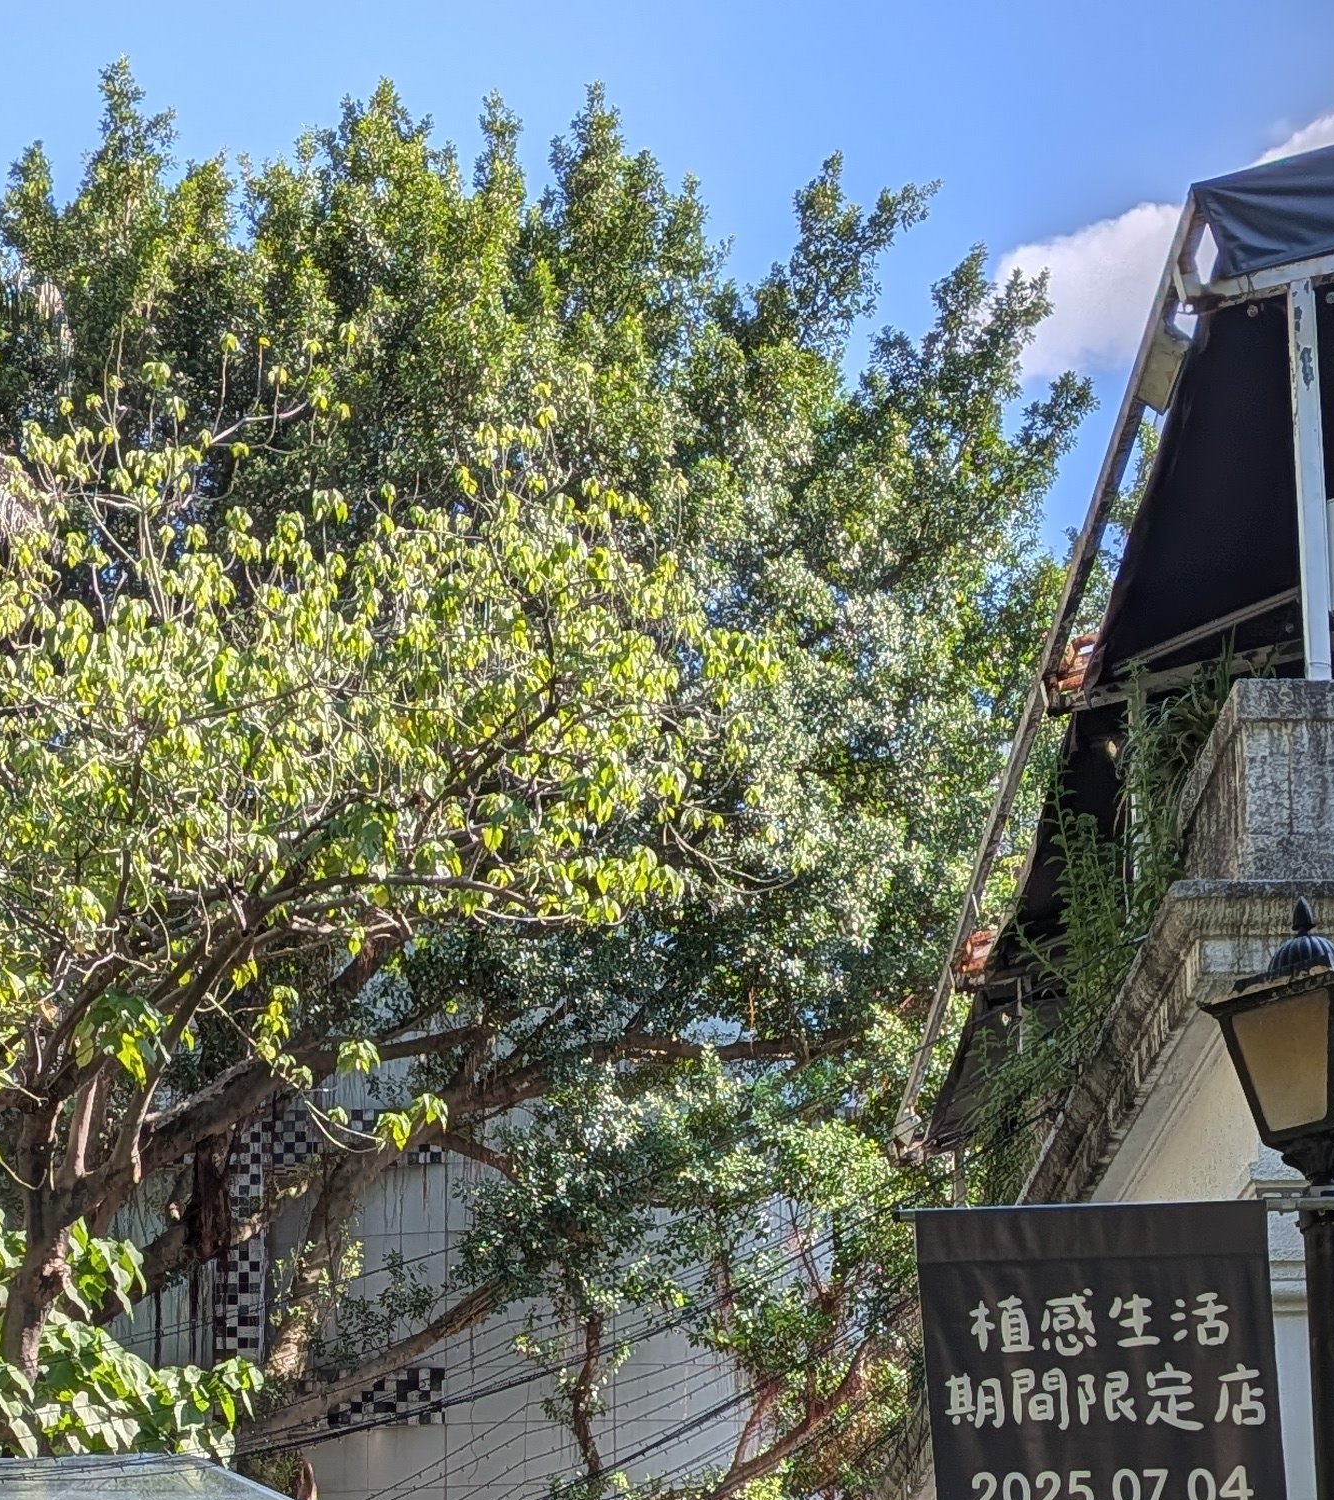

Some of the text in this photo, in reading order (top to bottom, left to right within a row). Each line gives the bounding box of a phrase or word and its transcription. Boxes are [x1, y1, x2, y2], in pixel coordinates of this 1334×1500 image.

[969, 1288, 1230, 1356] 植感生活
[945, 1362, 1266, 1430] 期間限定店
